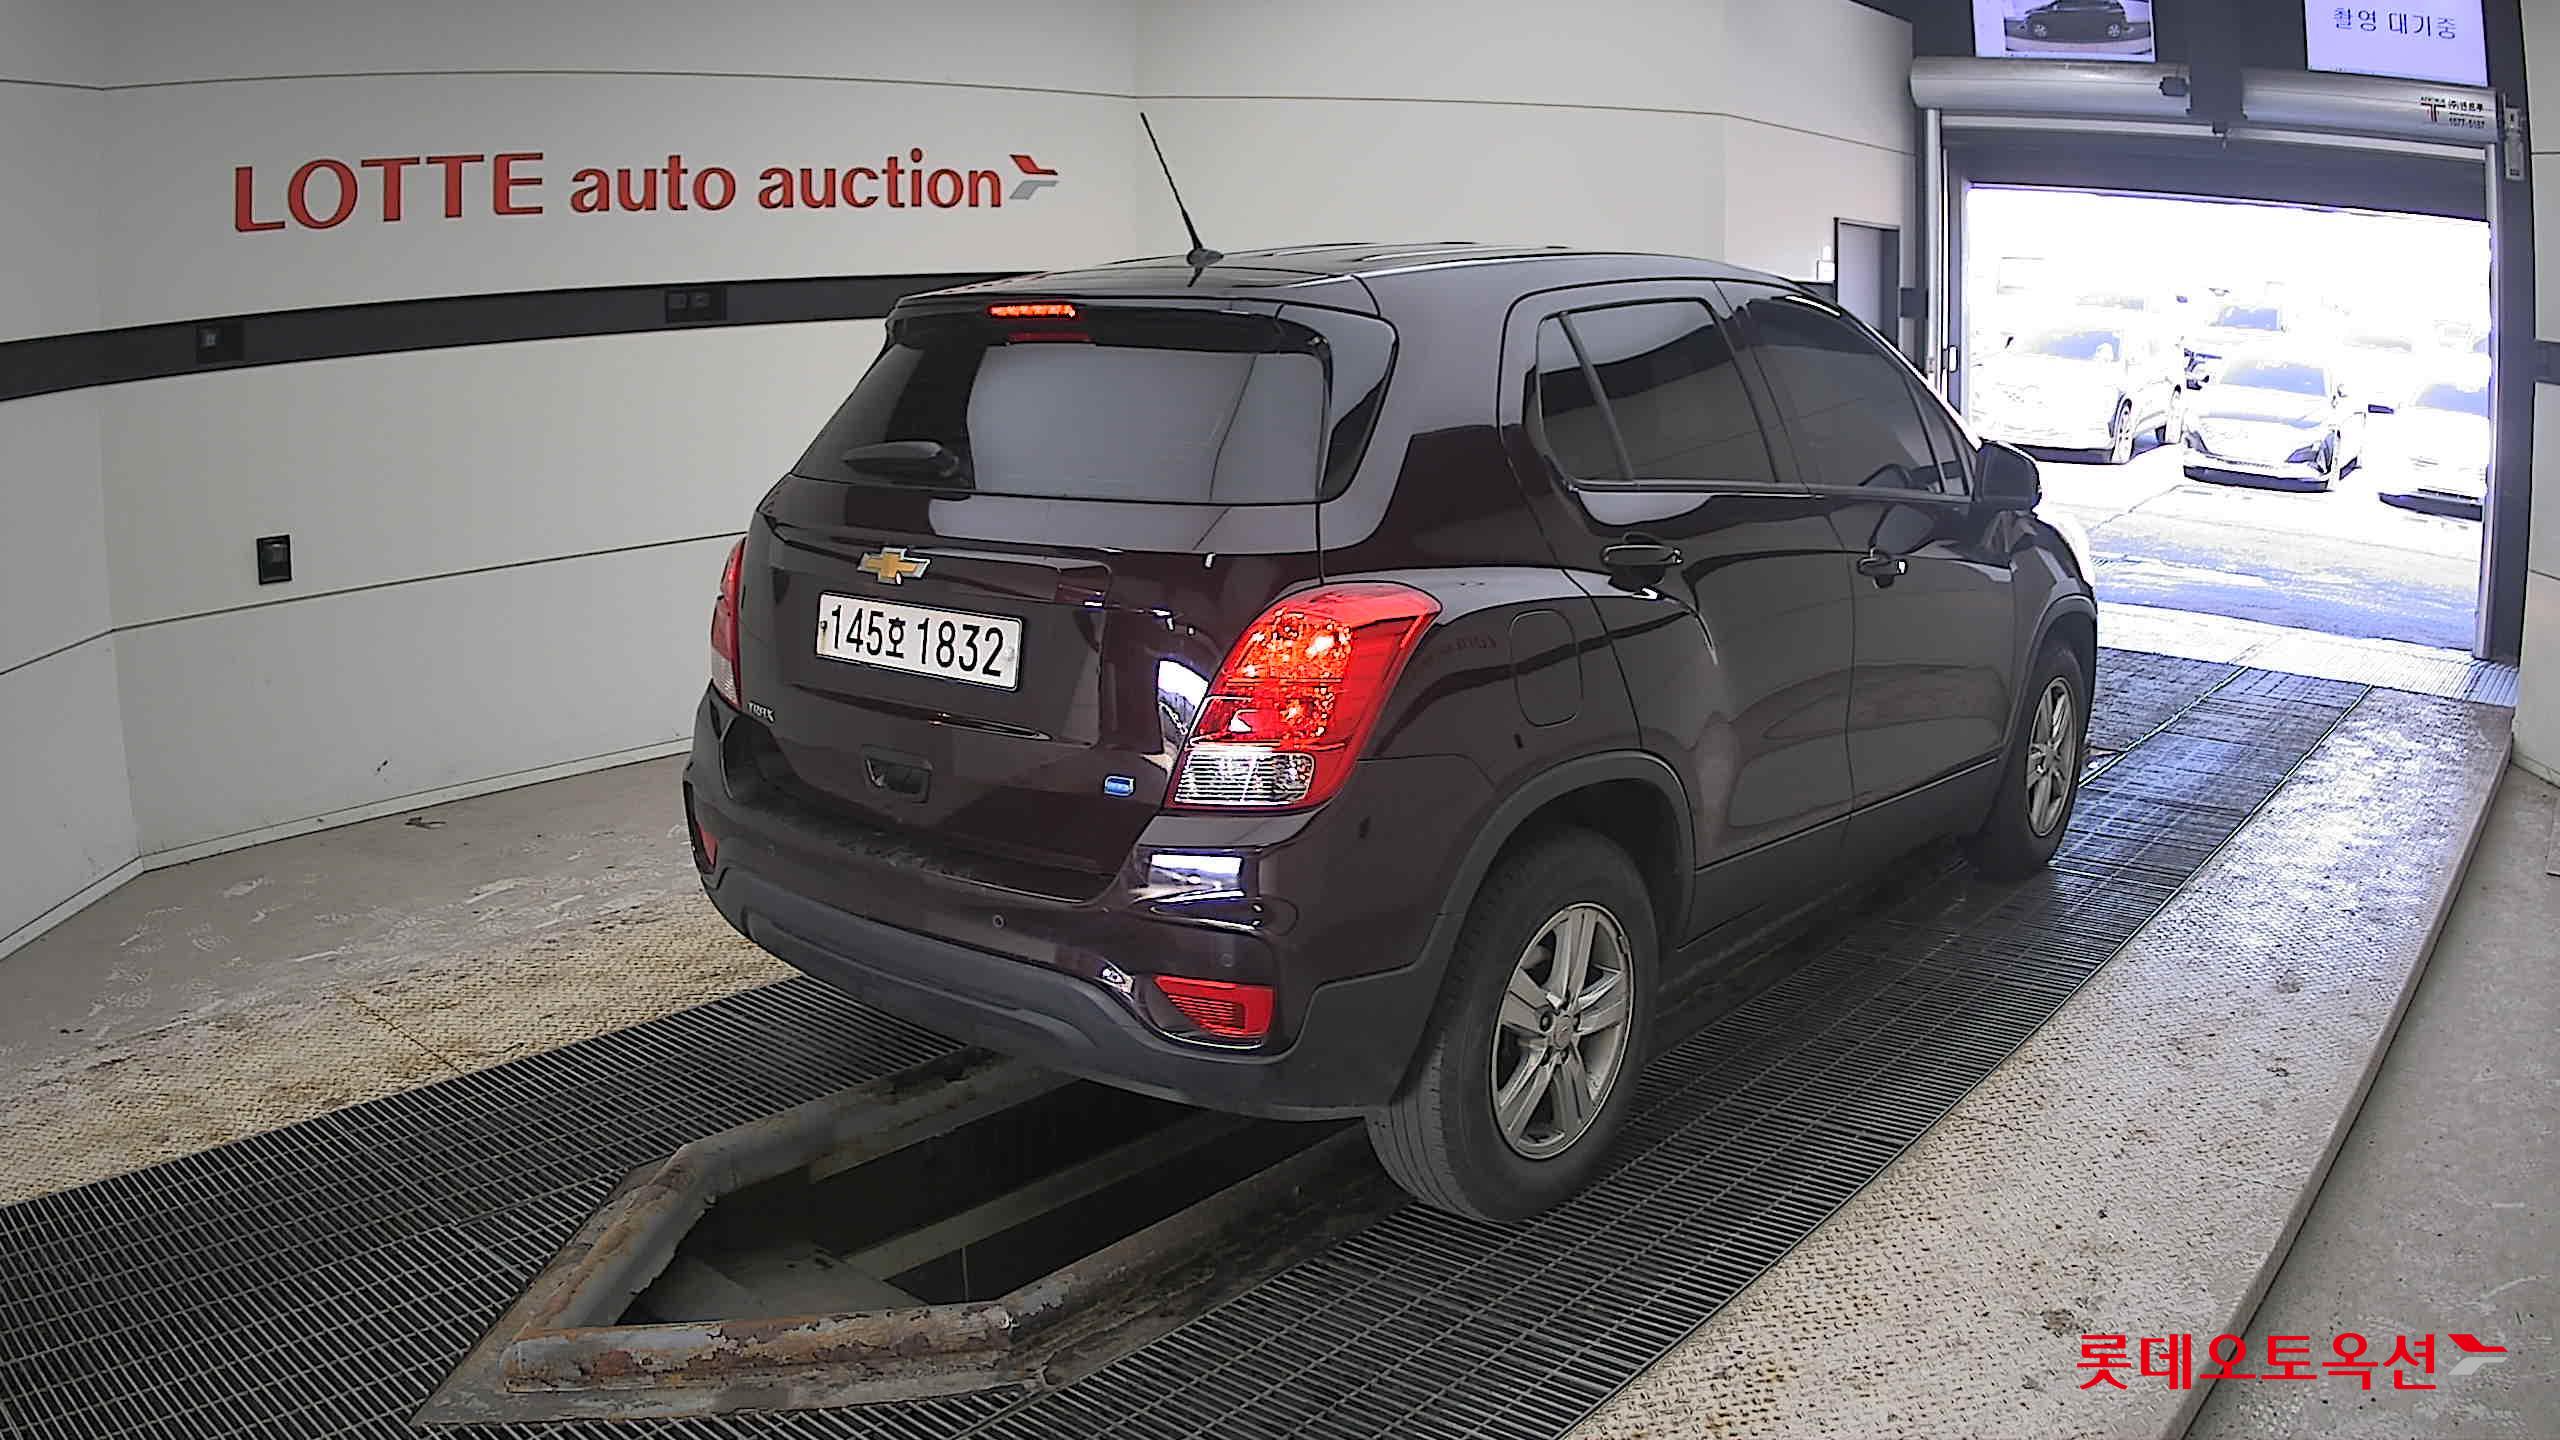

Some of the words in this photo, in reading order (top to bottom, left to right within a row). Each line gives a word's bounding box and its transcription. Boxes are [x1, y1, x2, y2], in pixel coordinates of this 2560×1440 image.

[235, 152, 543, 232] LOTTE
[570, 155, 736, 213] auto
[757, 148, 1003, 208] auction
[831, 604, 905, 658] 145호
[917, 616, 1004, 676] 1832
